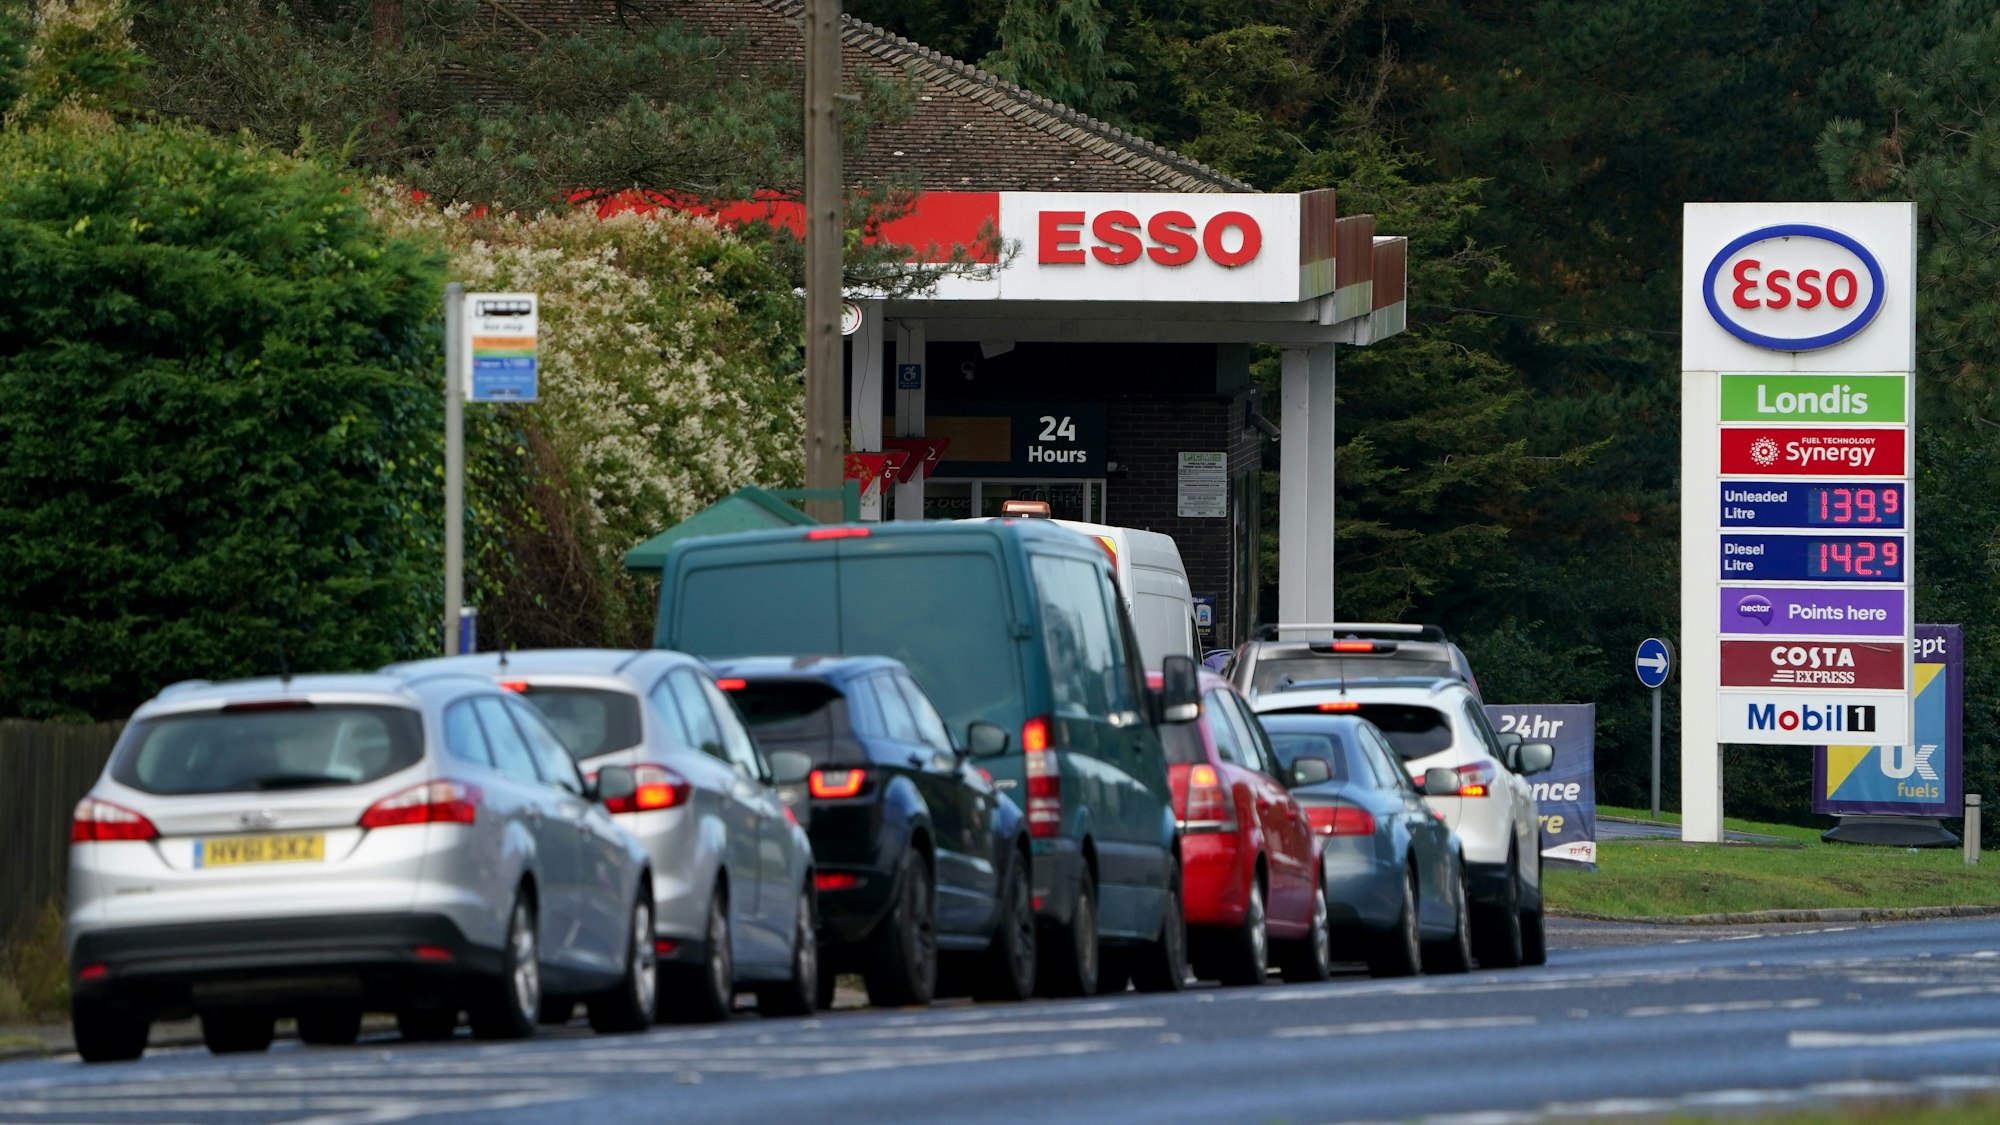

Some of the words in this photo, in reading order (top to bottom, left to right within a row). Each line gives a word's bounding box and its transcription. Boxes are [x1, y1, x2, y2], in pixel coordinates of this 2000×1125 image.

[1038, 210, 1263, 267] ESSO
[1732, 259, 1859, 310] Esso
[1757, 384, 1869, 415] Londis
[1038, 415, 1076, 442] 24
[1801, 437, 1821, 445] FUEL
[1822, 437, 1876, 445] TECHNOLOGY
[926, 447, 937, 461] 2
[1028, 445, 1087, 463] Hours
[1785, 441, 1876, 467] Synergy
[884, 469, 892, 479] 6
[1724, 490, 1788, 503] Unleaded
[1819, 488, 1899, 523] 139.9
[1724, 507, 1756, 520] Litre
[1724, 543, 1765, 555] Diesel
[1819, 541, 1899, 576] 142.9
[1724, 559, 1755, 571] Litre
[1740, 604, 1771, 613] nectar
[1788, 603, 1844, 620] Points
[1847, 605, 1887, 621] here
[1770, 646, 1856, 669] COSTA
[1795, 670, 1856, 685] EXPRESS
[1500, 714, 1564, 739] 24hr
[1748, 703, 1842, 732] Mobil
[1880, 744, 1940, 781] UK
[1528, 782, 1580, 801] nce
[1897, 782, 1939, 799] fuels
